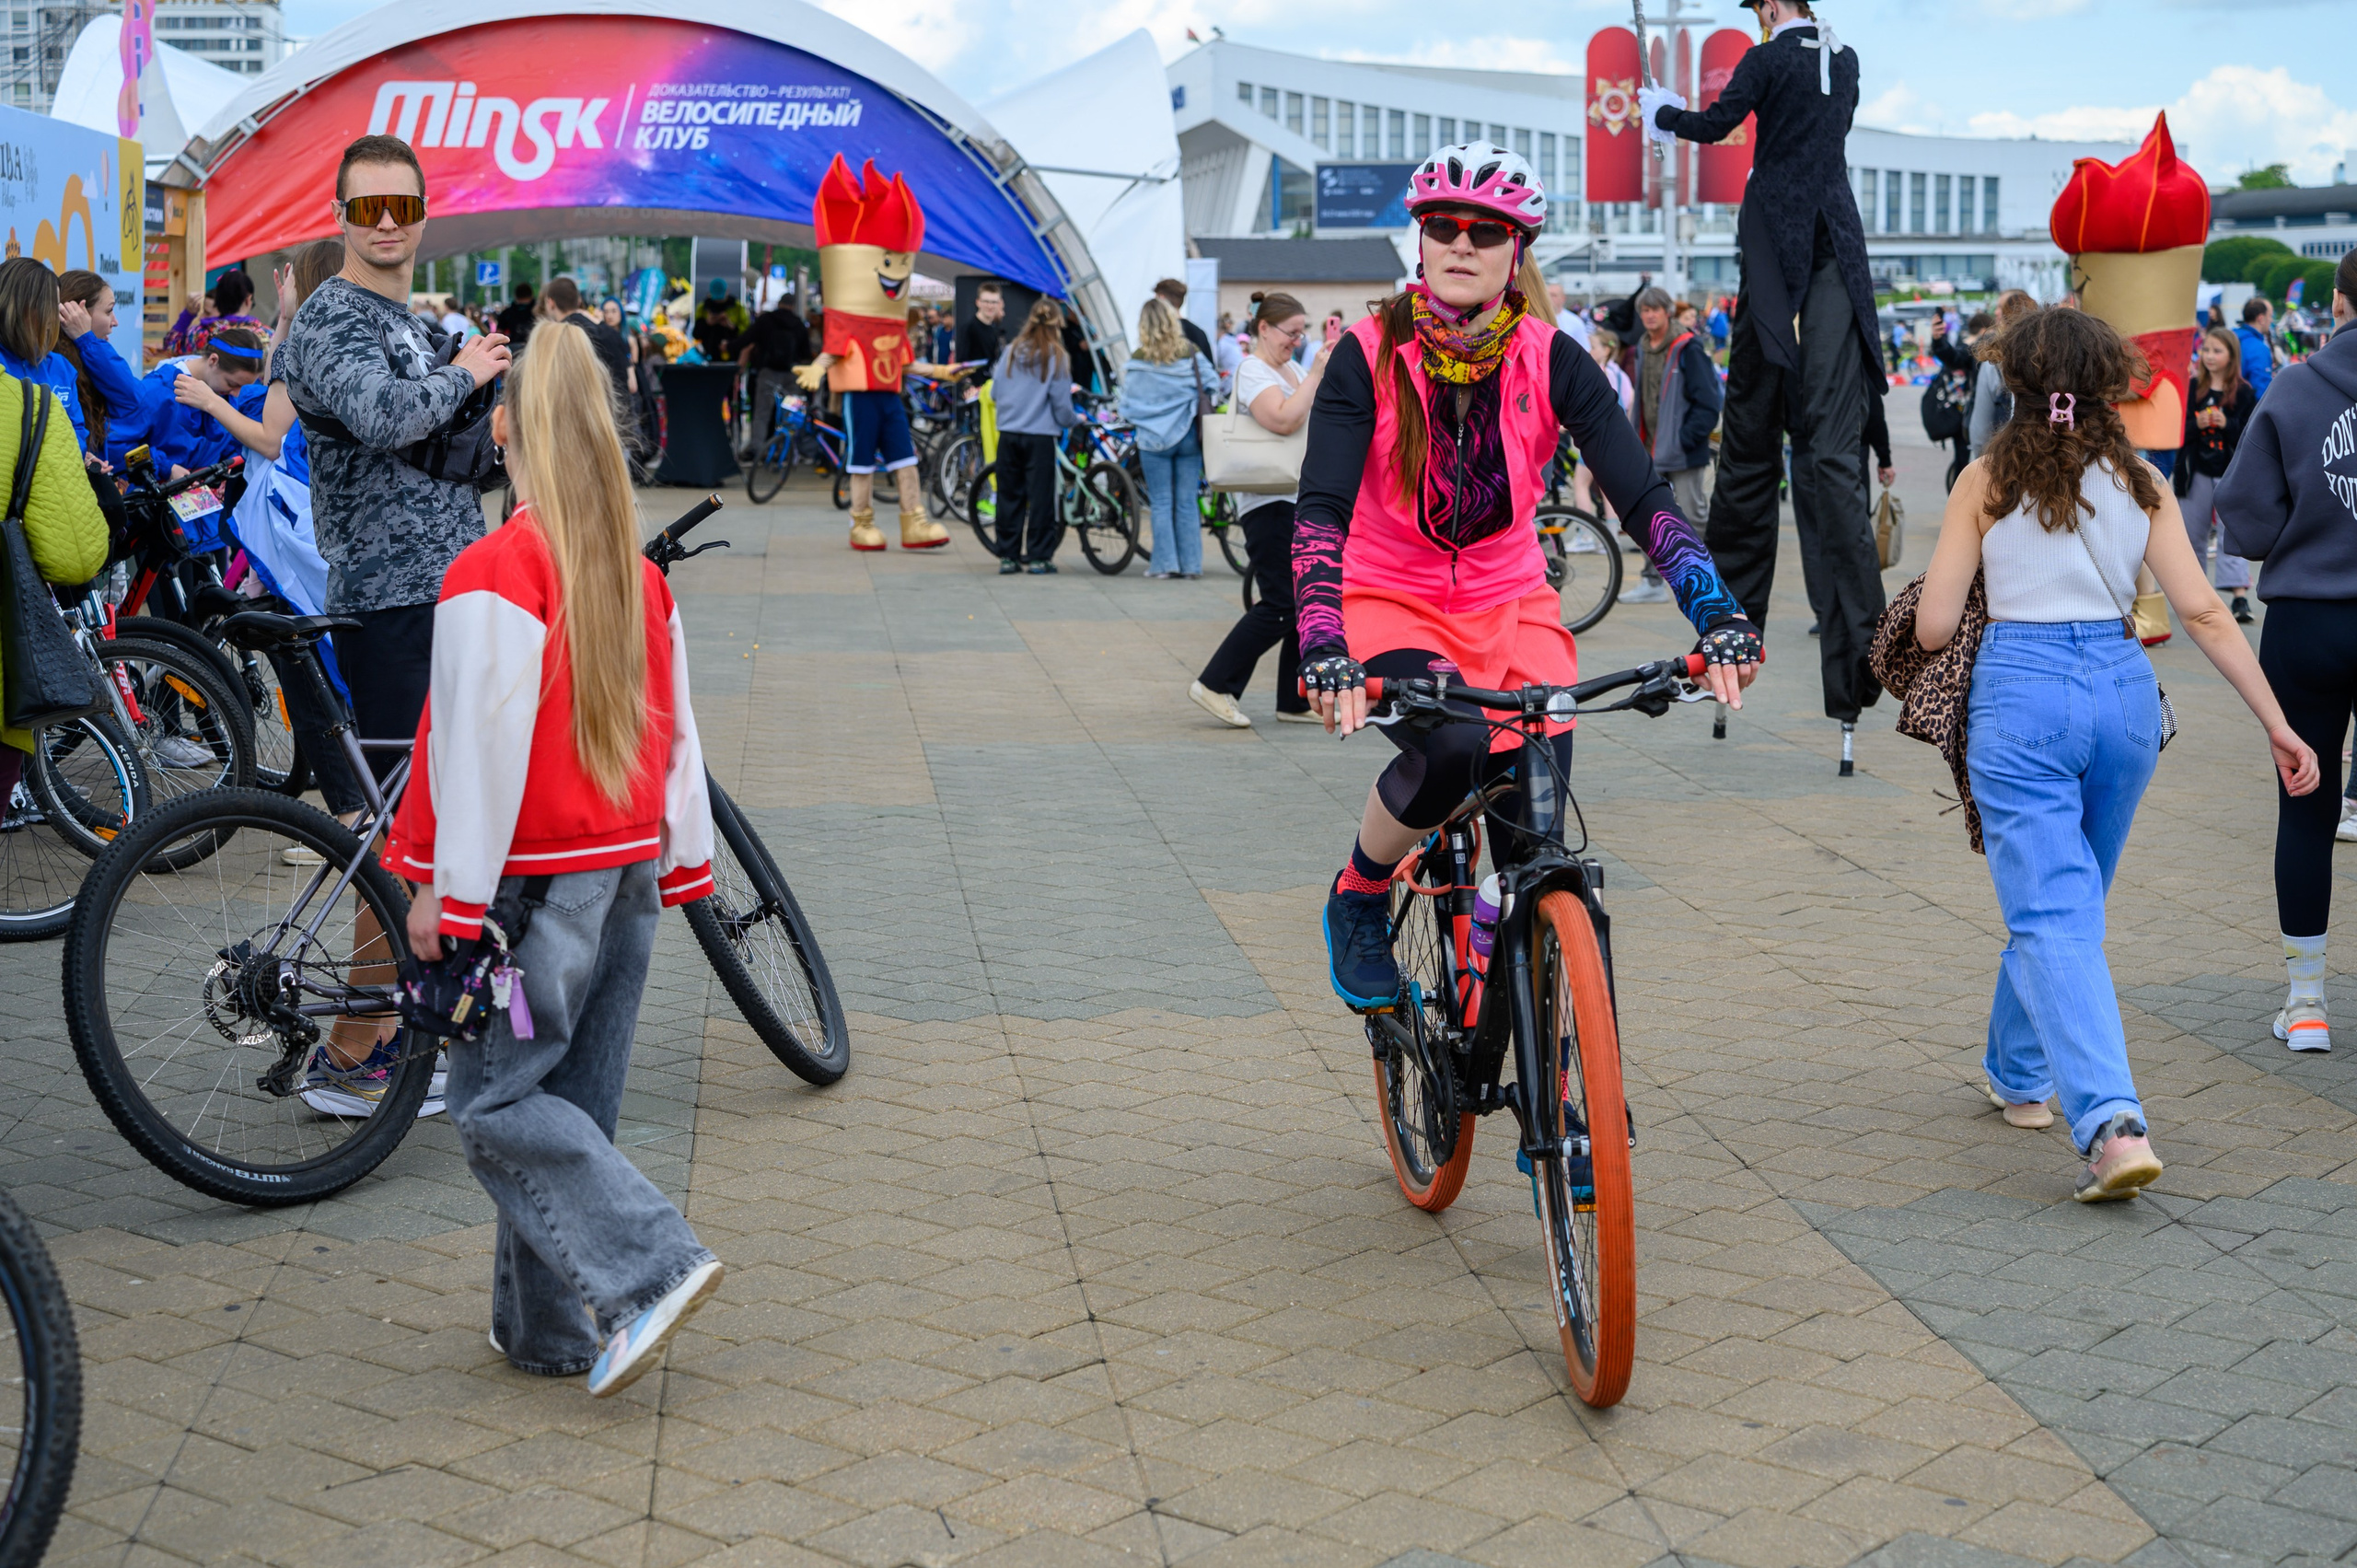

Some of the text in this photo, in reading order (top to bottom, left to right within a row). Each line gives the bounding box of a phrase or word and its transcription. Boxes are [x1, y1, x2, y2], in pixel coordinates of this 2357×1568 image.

[646, 82, 769, 99] ДОКАЗАТЕЛЬСТВО
[640, 99, 864, 132] ВЕЛОСИПЕДНЫЙ
[633, 125, 712, 151] КЛУБ
[117, 744, 140, 788] KENDA
[192, 1149, 282, 1183] WTB RANGER
